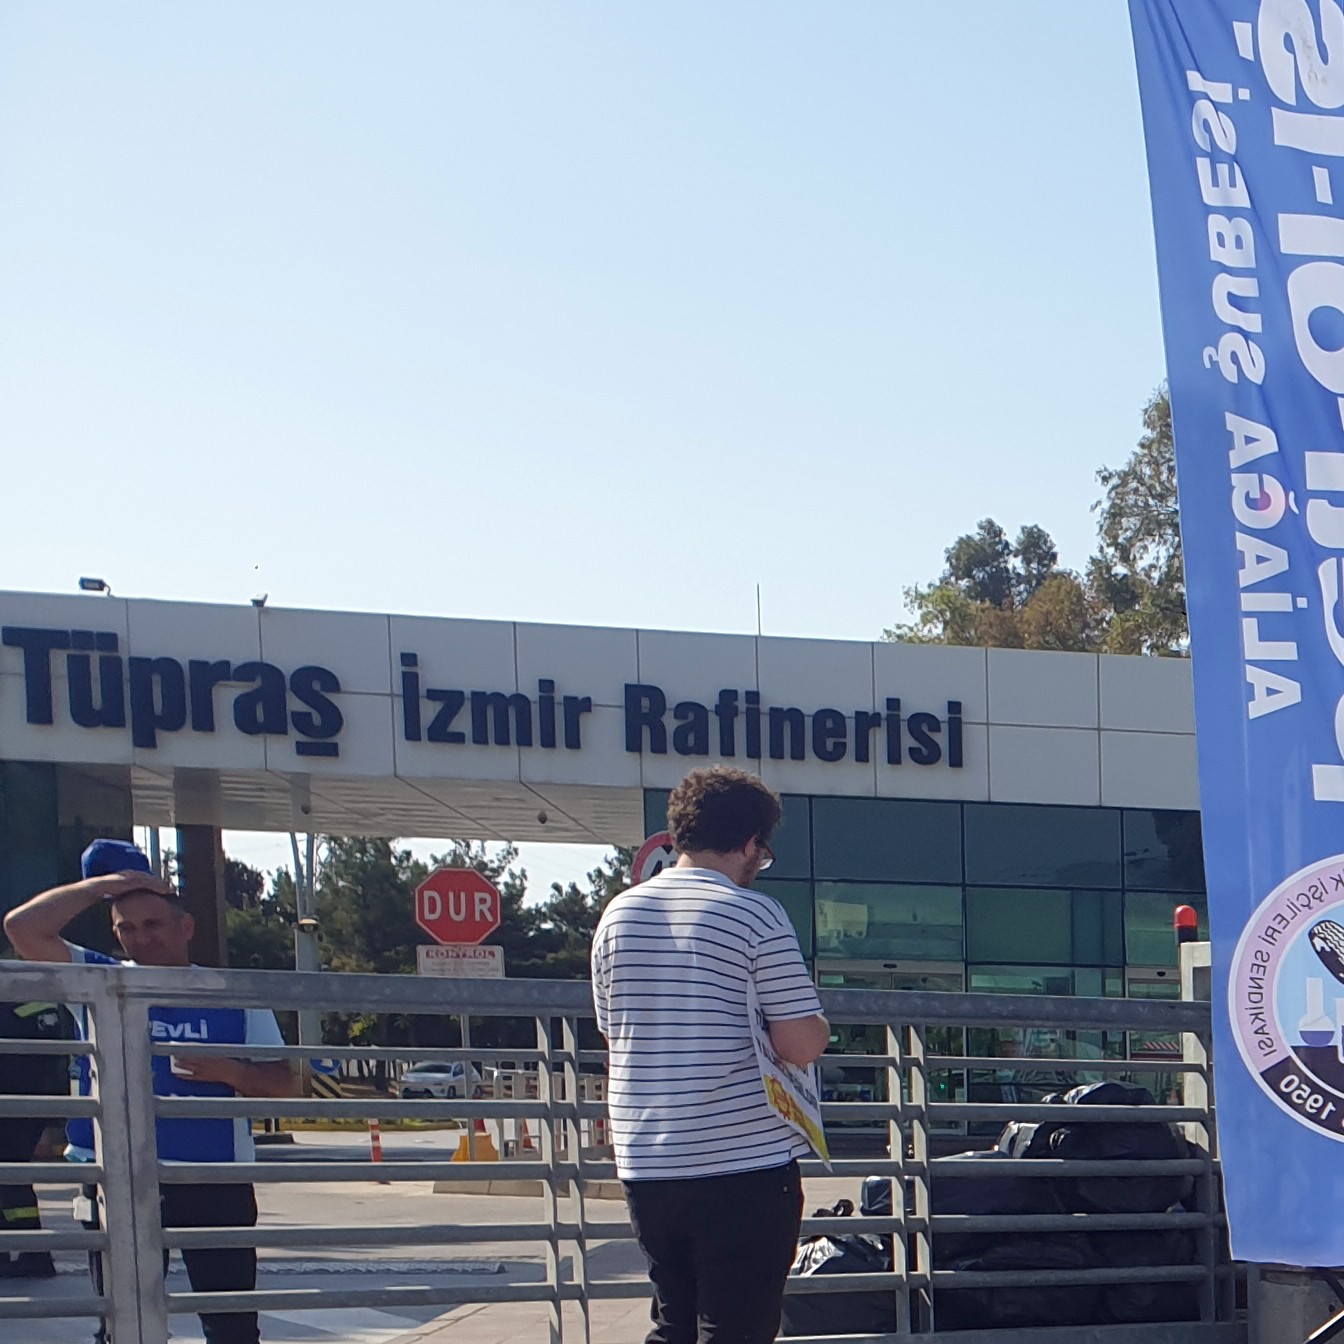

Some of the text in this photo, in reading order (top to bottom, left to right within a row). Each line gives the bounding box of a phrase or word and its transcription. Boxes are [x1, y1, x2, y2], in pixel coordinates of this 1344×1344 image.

[2, 626, 964, 769] Tüpraş İzmir Rafinerisi
[423, 889, 493, 923] DUR
[151, 1018, 209, 1039] EVLİ
